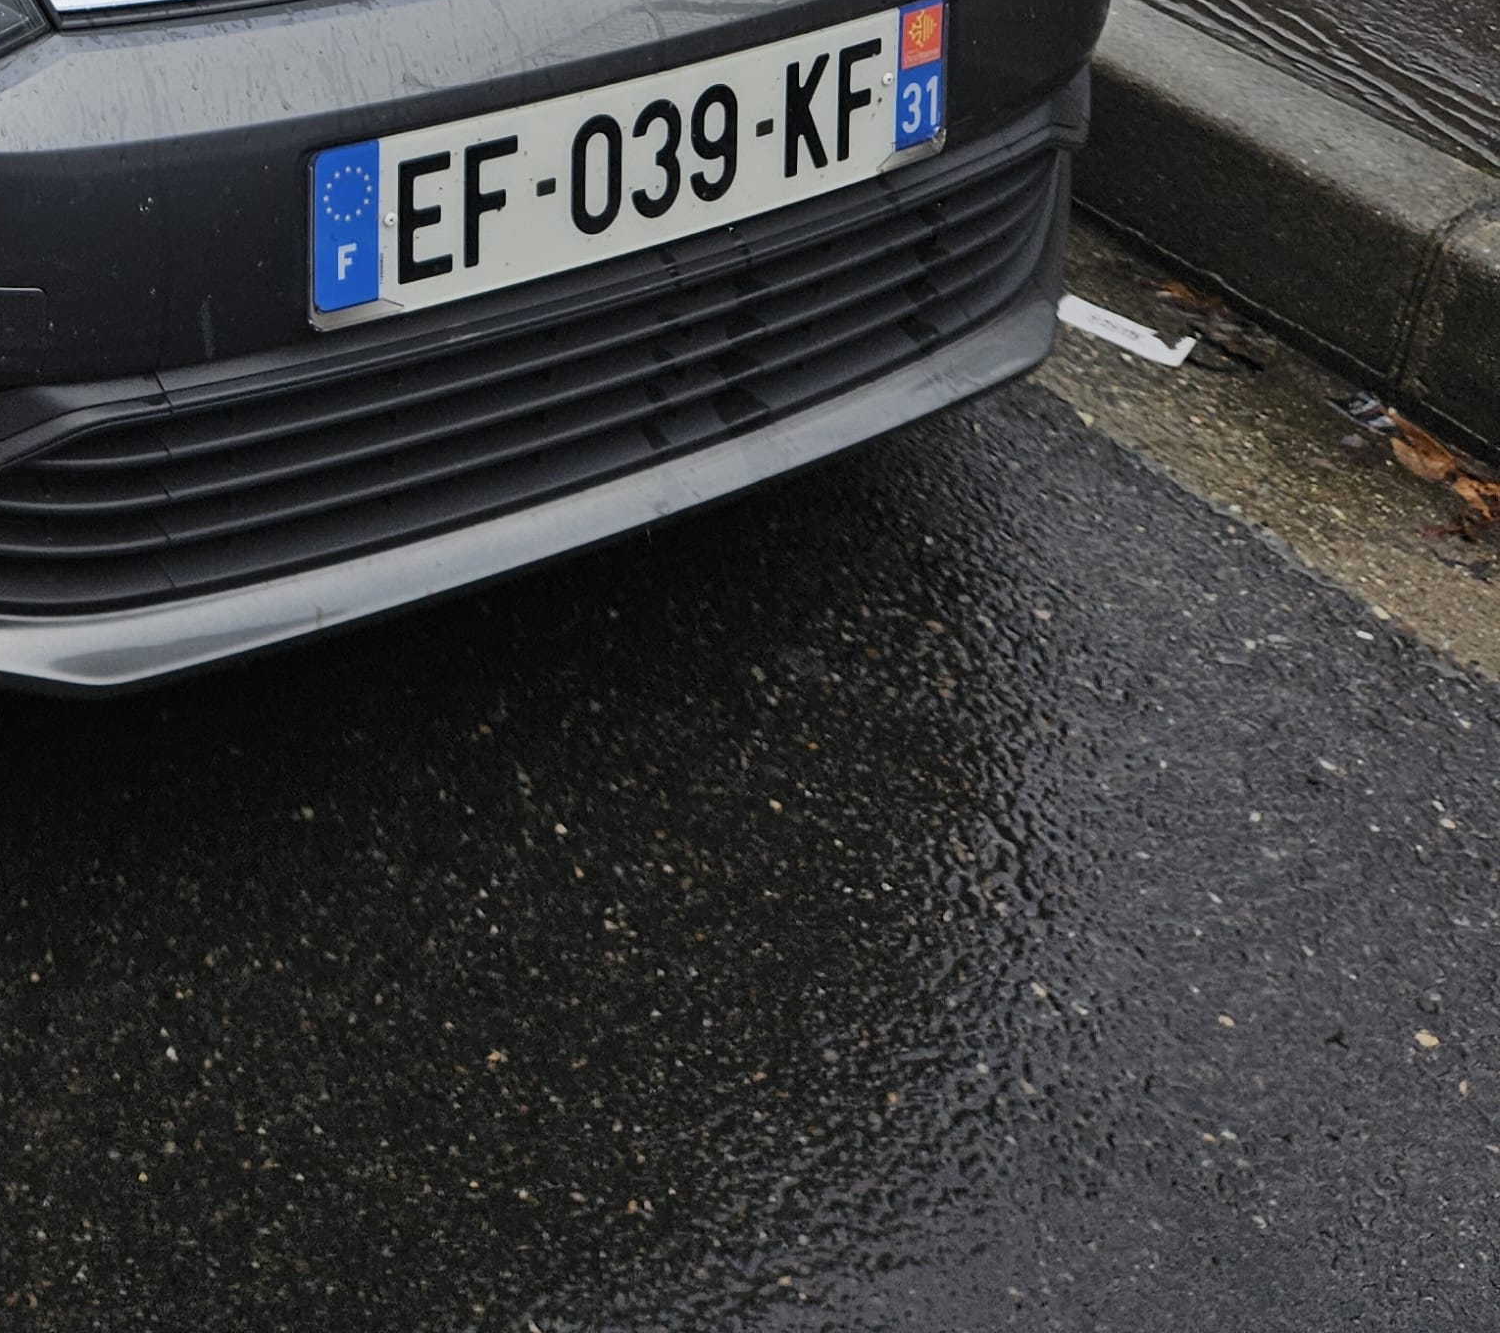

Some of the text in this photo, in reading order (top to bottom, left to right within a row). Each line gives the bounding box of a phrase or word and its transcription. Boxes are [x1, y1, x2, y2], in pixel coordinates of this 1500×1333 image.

[902, 74, 939, 134] 31
[397, 36, 883, 286] EF-039-KF
[337, 242, 357, 281] F
